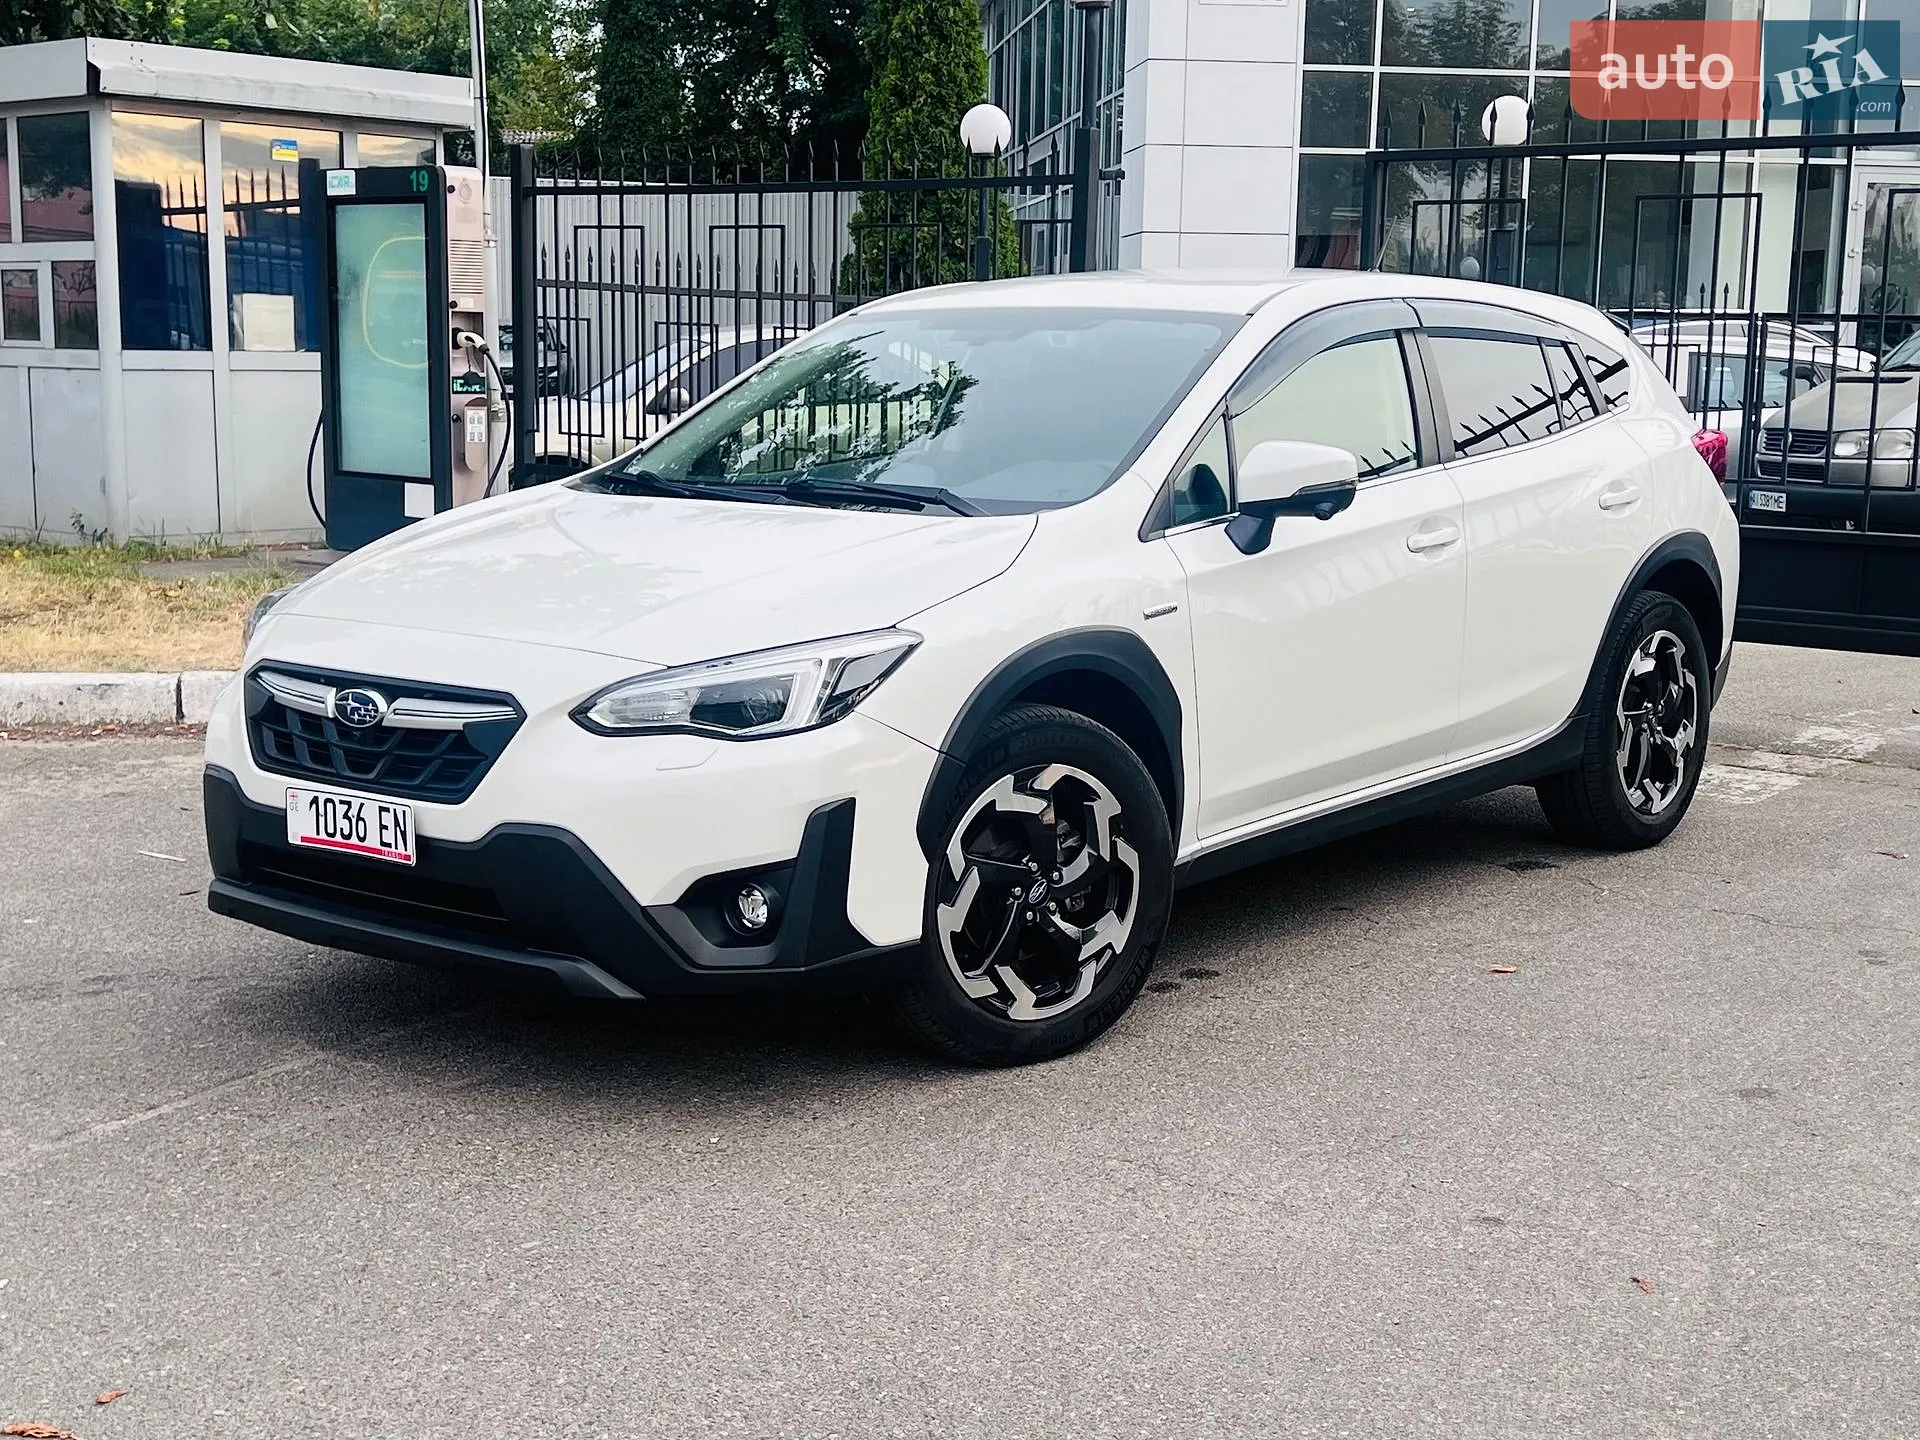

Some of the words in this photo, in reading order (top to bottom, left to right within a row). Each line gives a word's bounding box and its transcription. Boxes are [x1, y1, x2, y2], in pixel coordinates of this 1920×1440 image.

[409, 170, 429, 192] 19
[289, 801, 299, 812] GE
[309, 795, 368, 843] 1036
[378, 805, 408, 851] EN
